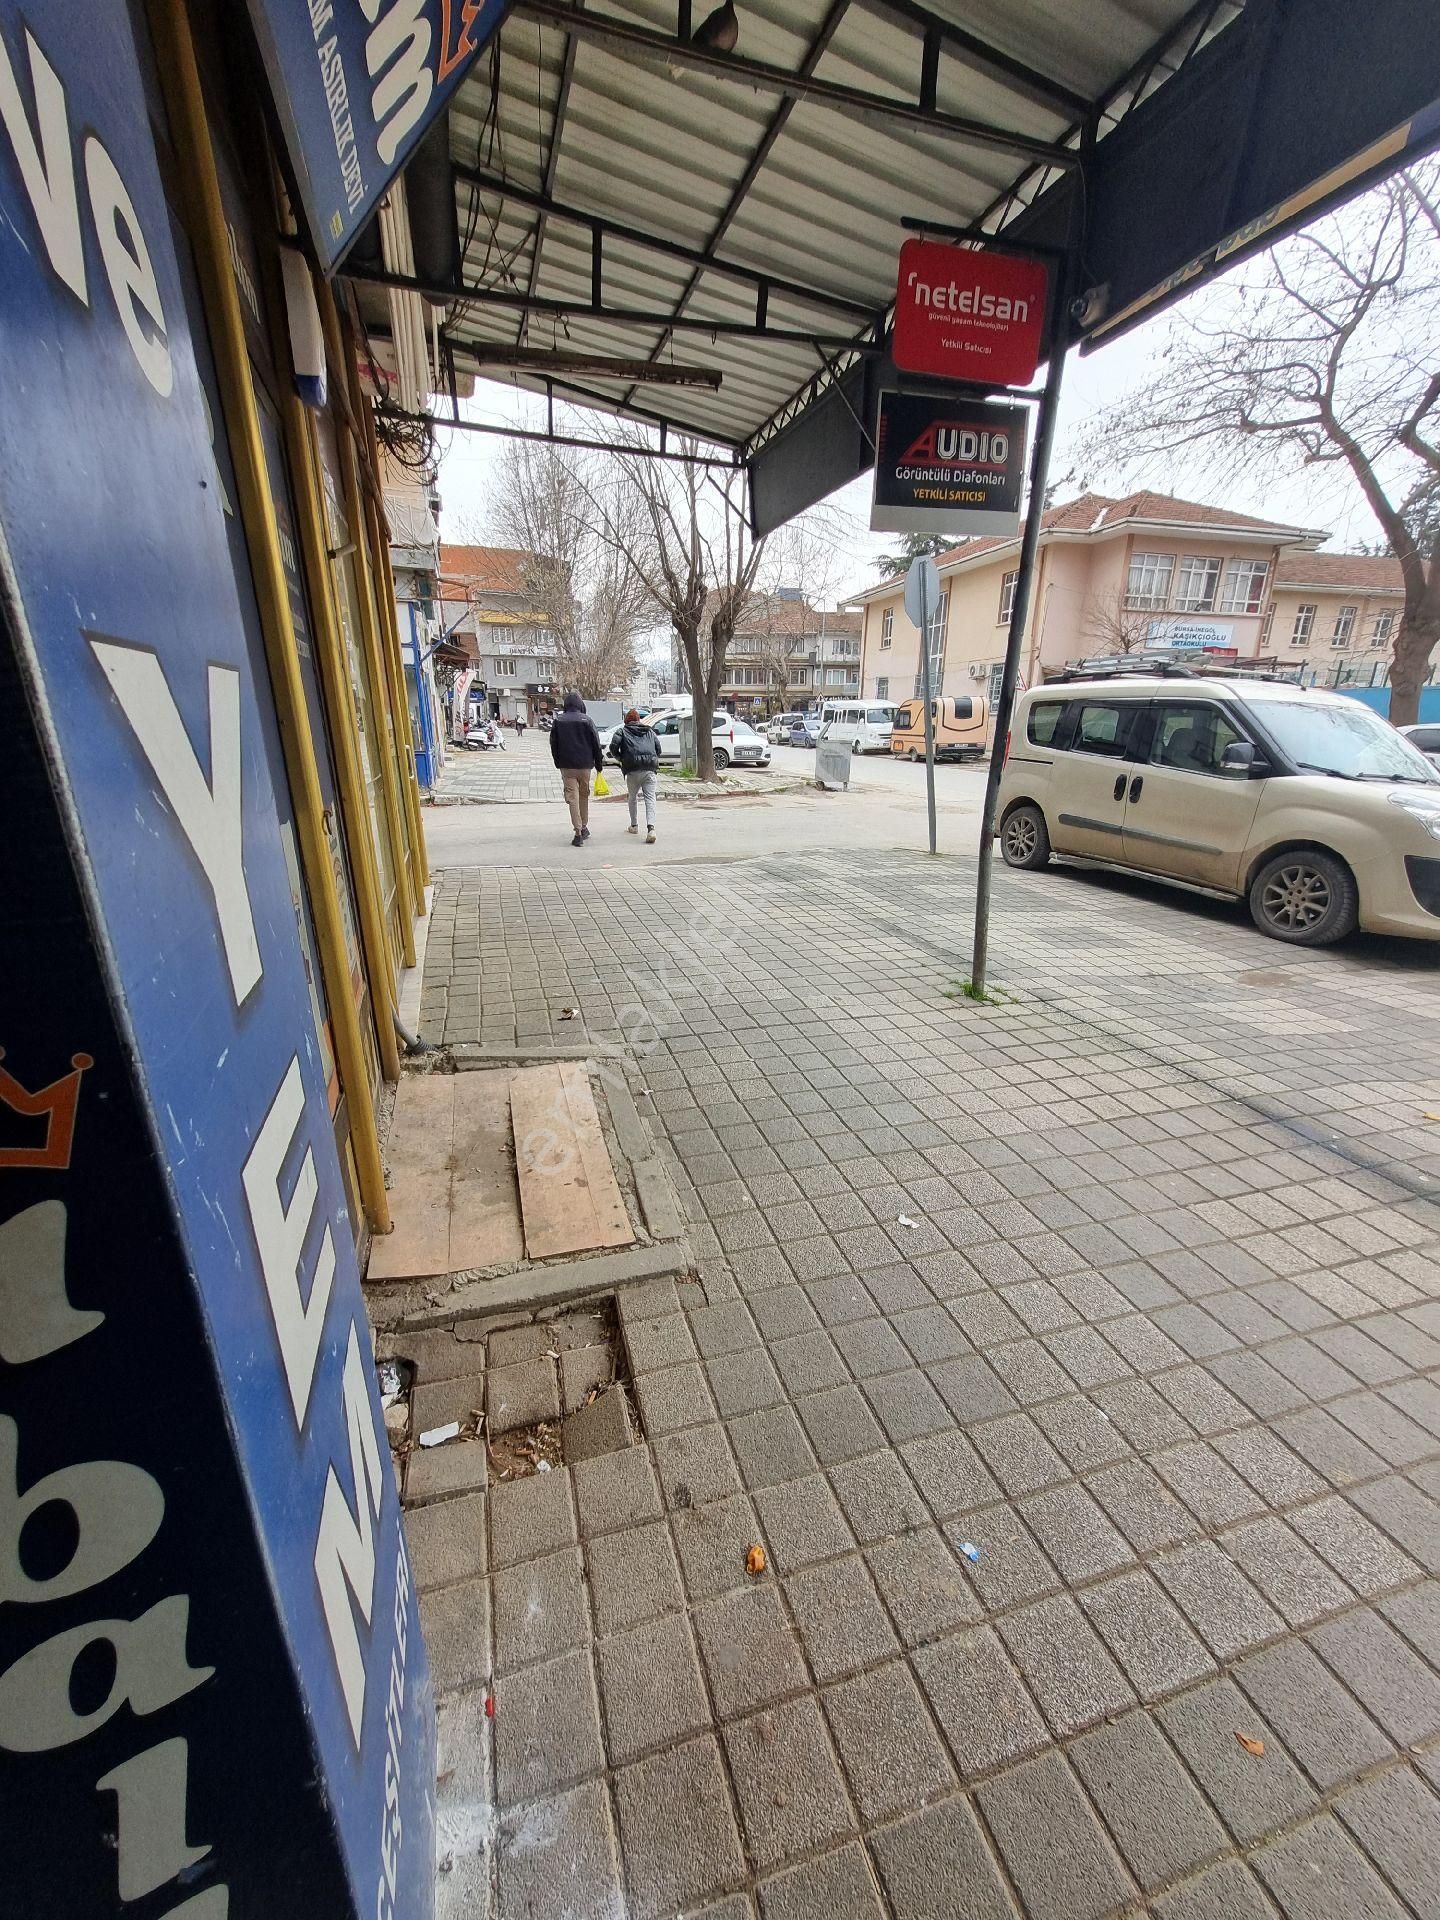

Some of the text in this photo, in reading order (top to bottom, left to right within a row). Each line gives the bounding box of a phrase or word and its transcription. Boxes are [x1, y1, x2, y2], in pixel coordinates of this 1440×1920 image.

[318, 35, 355, 158] ASIRLIK
[908, 271, 1028, 323] netelsan
[941, 337, 963, 350] Yetkili
[897, 421, 1009, 467] AUDIO
[895, 466, 1006, 486] Görüntülü Diafonları
[913, 487, 986, 502] YETKİLİ SATICISI
